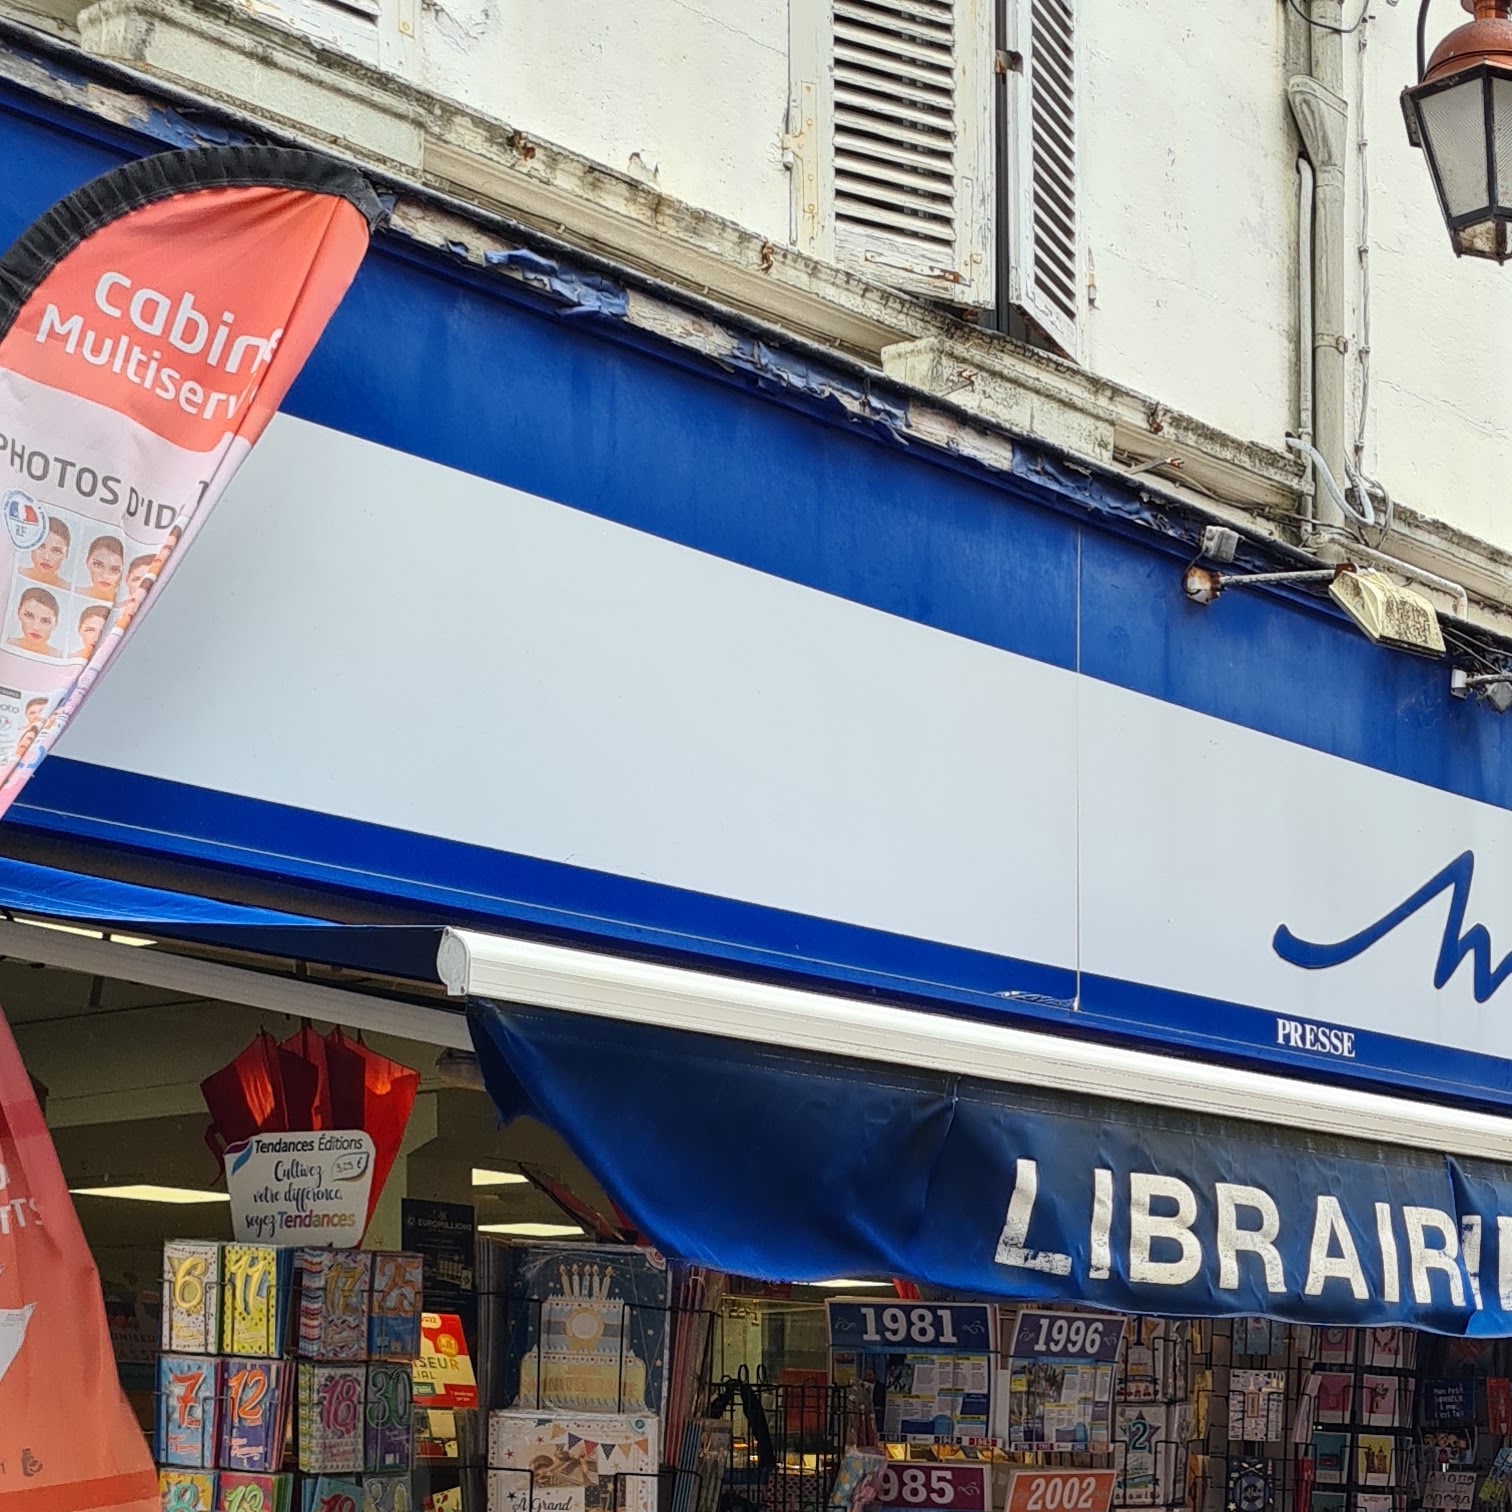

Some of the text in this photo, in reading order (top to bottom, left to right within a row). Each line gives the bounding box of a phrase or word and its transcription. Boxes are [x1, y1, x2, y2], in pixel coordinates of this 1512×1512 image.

[1275, 1018, 1356, 1059] PRESSE
[255, 1134, 363, 1154] Tendances Éditions
[273, 1158, 325, 1188] Cultivez
[277, 1210, 356, 1230] Tendances
[173, 1256, 206, 1309] 6
[859, 1306, 959, 1344] 1981
[1033, 1318, 1104, 1354] 1996
[172, 1367, 411, 1435] 7 12 18 30
[878, 1468, 1098, 1512] 985 2002
